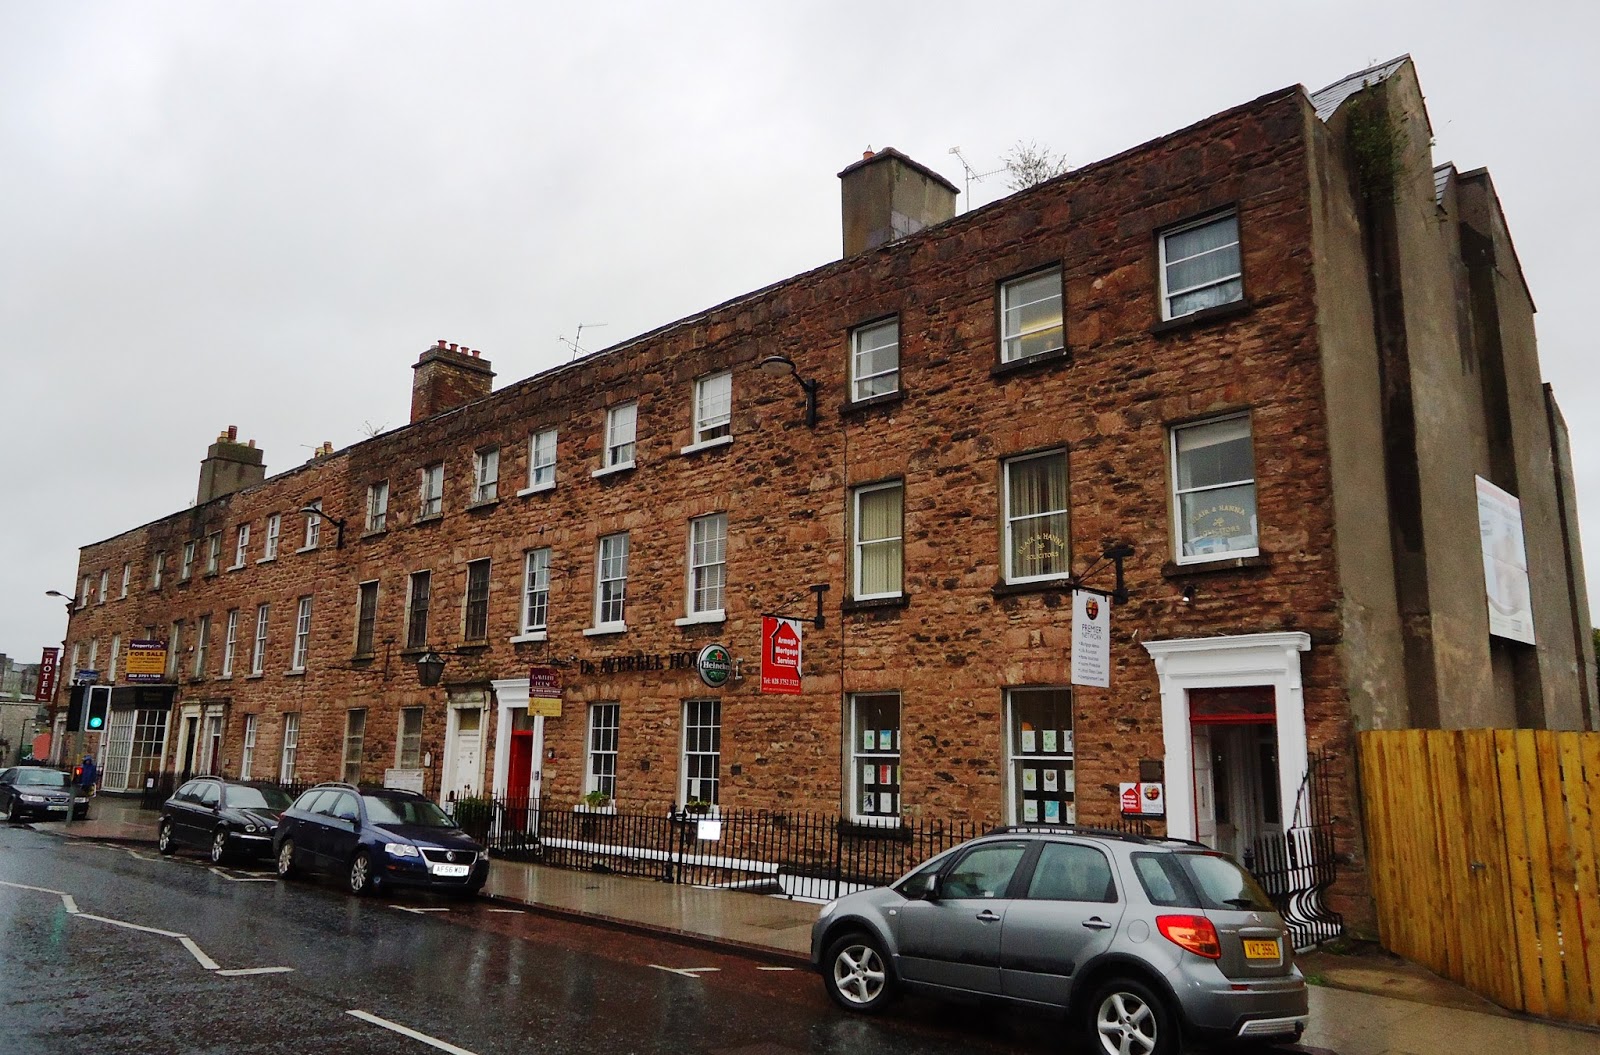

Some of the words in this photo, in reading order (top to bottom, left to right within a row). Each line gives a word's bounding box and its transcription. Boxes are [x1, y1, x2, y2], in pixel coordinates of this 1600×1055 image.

[778, 636, 797, 647] Armagh
[775, 646, 799, 657] Mortgage
[669, 651, 700, 670] HOU
[777, 656, 797, 666] Services
[40, 657, 53, 695] HOTEL
